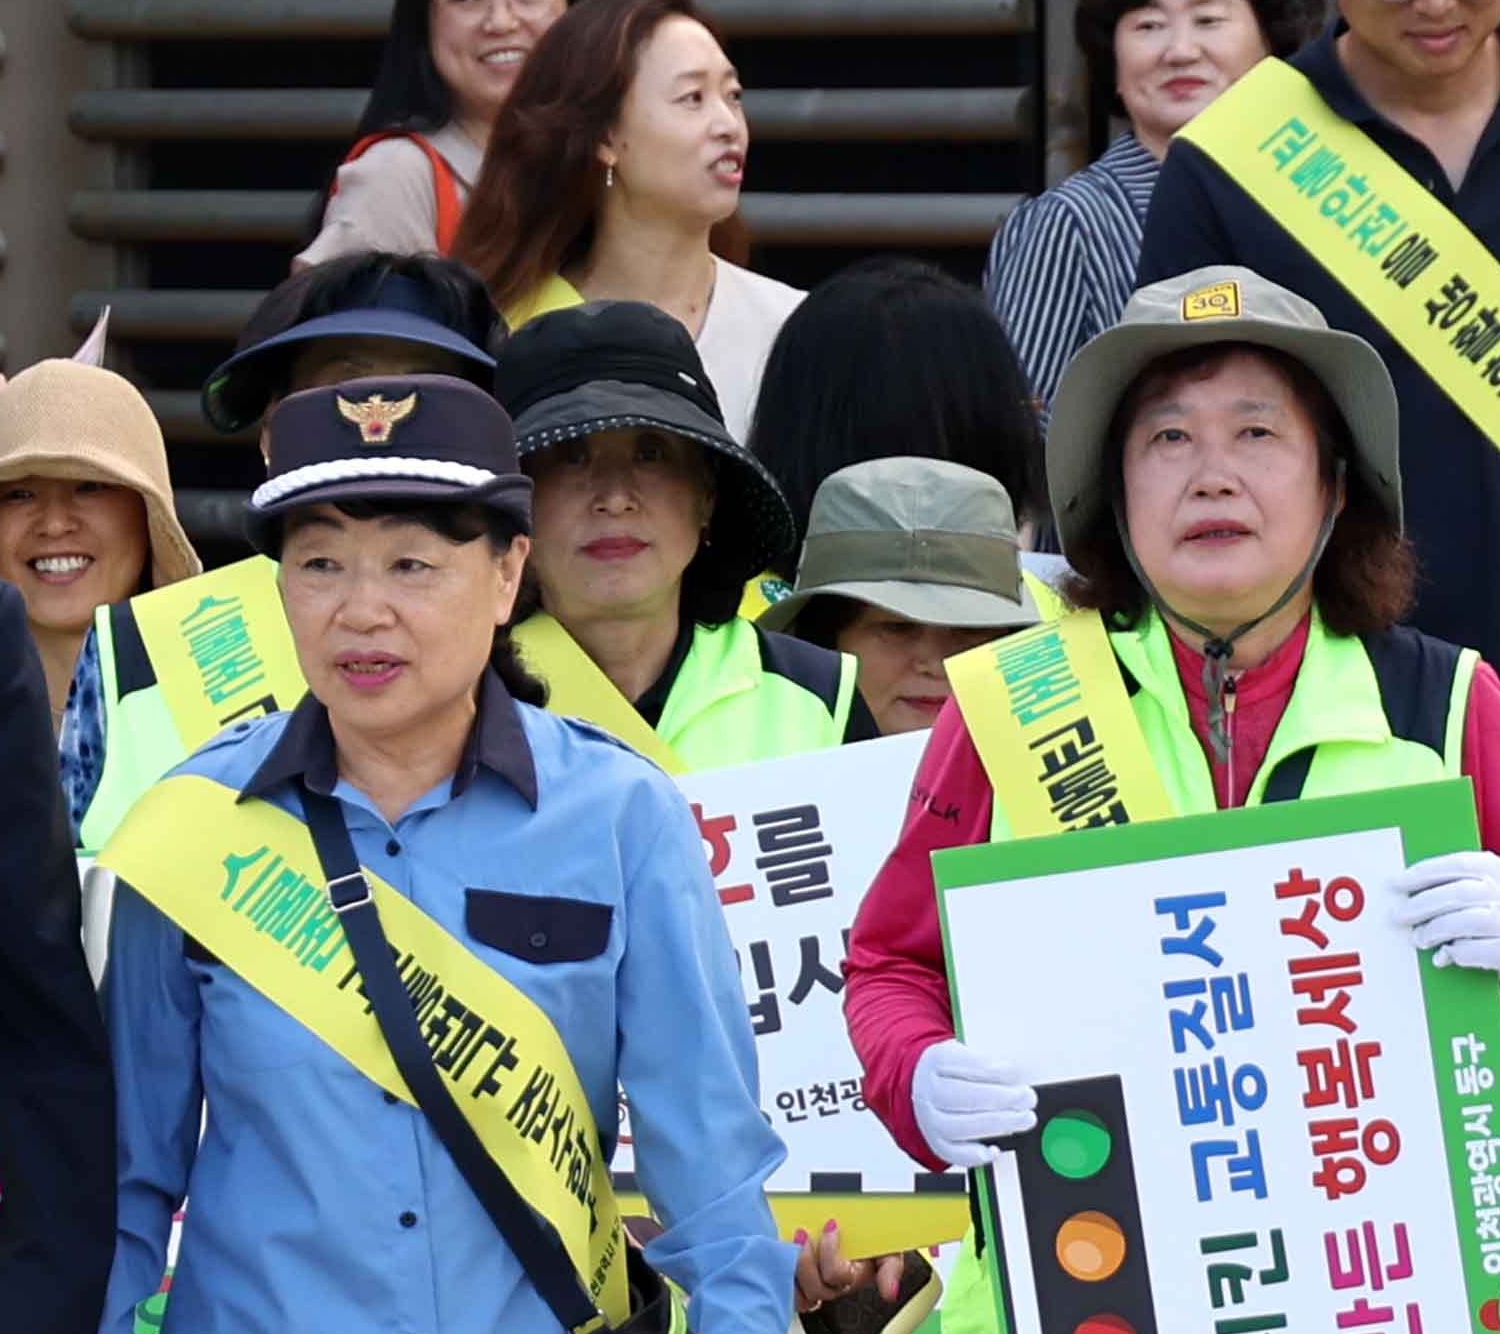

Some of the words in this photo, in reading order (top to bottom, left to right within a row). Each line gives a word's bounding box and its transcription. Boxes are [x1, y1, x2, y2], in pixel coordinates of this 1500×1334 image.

[1259, 117, 1442, 290] 교통안전을
[180, 595, 265, 705] 스쿨존
[220, 844, 349, 974] 스쿨존
[1152, 890, 1271, 1204] 교통질서
[1273, 867, 1403, 1201] 행복세상
[1449, 1031, 1498, 1092] 동구
